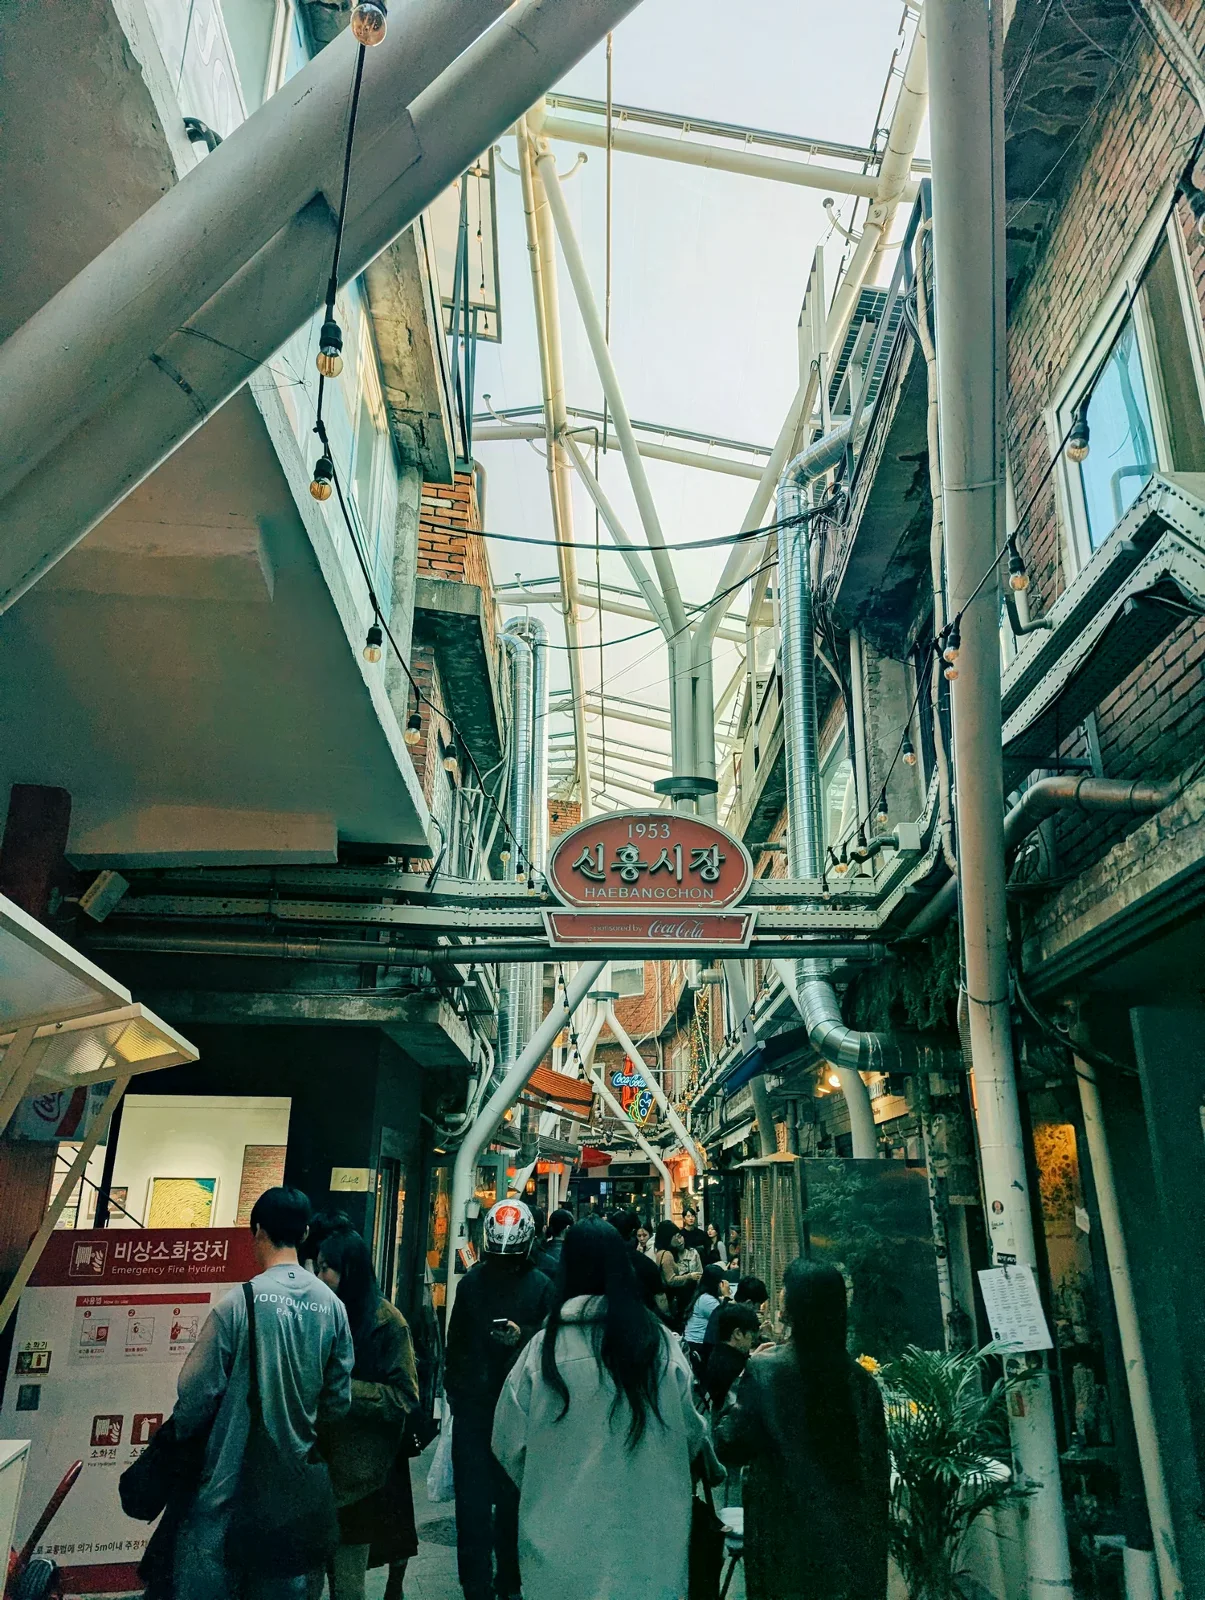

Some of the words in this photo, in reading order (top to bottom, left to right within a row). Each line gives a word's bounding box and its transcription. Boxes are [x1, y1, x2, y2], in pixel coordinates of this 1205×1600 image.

[627, 823, 671, 839] 1953
[571, 842, 726, 882] 신흥시장
[584, 887, 714, 899] HAEBANGCHON
[632, 923, 643, 933] by
[114, 1239, 229, 1263] 비상소화장치
[111, 1266, 165, 1277] Emergency
[167, 1265, 186, 1274] Fire
[187, 1264, 226, 1276] Hydrant
[253, 1293, 332, 1316] OOYOUNGMI
[276, 1307, 303, 1321] PARIS
[24, 1341, 48, 1351] 소화기
[90, 1448, 117, 1460] 소화전
[77, 1541, 93, 1554] 의거
[94, 1540, 123, 1553] 5m이내
